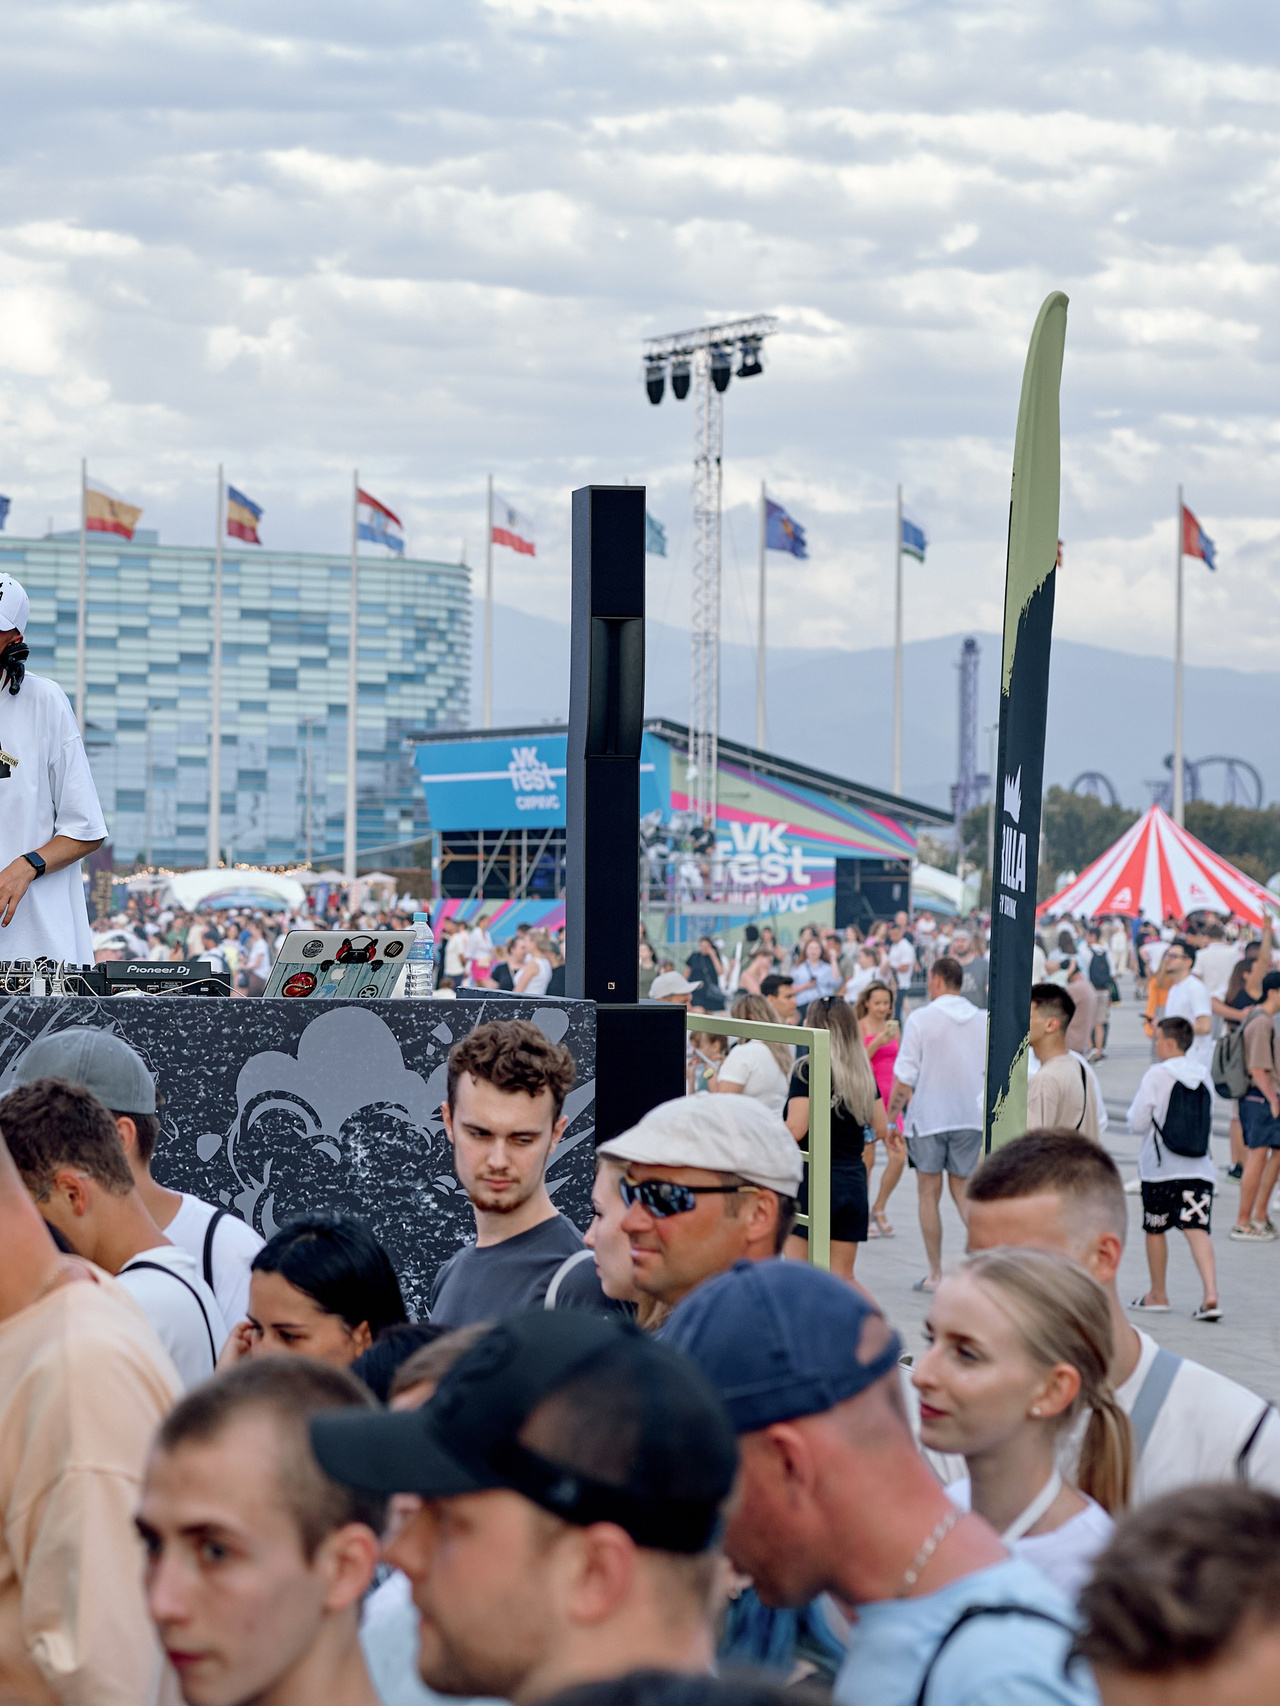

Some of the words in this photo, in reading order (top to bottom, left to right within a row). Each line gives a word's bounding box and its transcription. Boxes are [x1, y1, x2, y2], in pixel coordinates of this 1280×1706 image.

[1, 754, 19, 767] CONTENT
[511, 746, 540, 767] VK
[508, 761, 558, 792] fest
[729, 822, 789, 853] VK
[711, 840, 811, 887] fest
[126, 965, 175, 974] Pioneer
